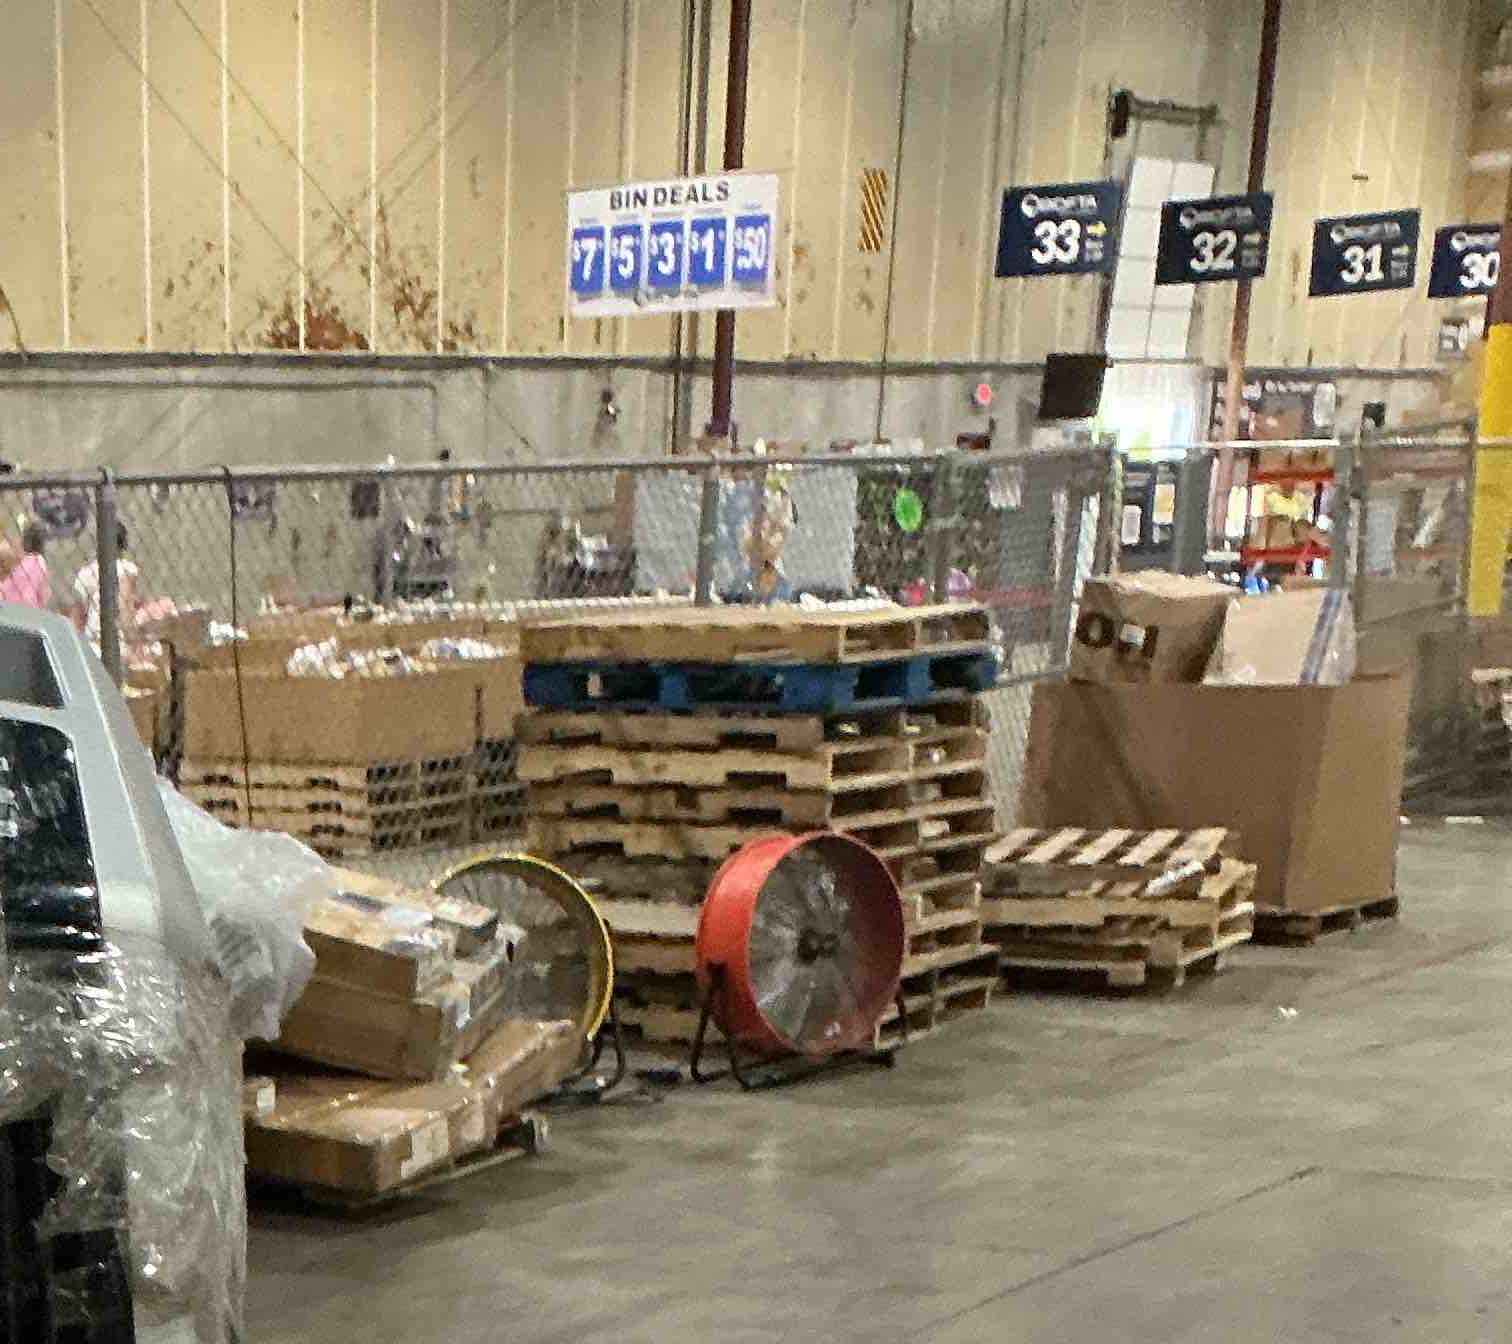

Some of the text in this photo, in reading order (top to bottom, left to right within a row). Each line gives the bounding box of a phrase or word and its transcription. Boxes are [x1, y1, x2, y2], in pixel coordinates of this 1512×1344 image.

[609, 180, 730, 210] BIN DEALS
[1031, 218, 1081, 265] 33
[1190, 229, 1238, 273] 32
[1341, 243, 1385, 284] 31
[1458, 250, 1501, 288] 30
